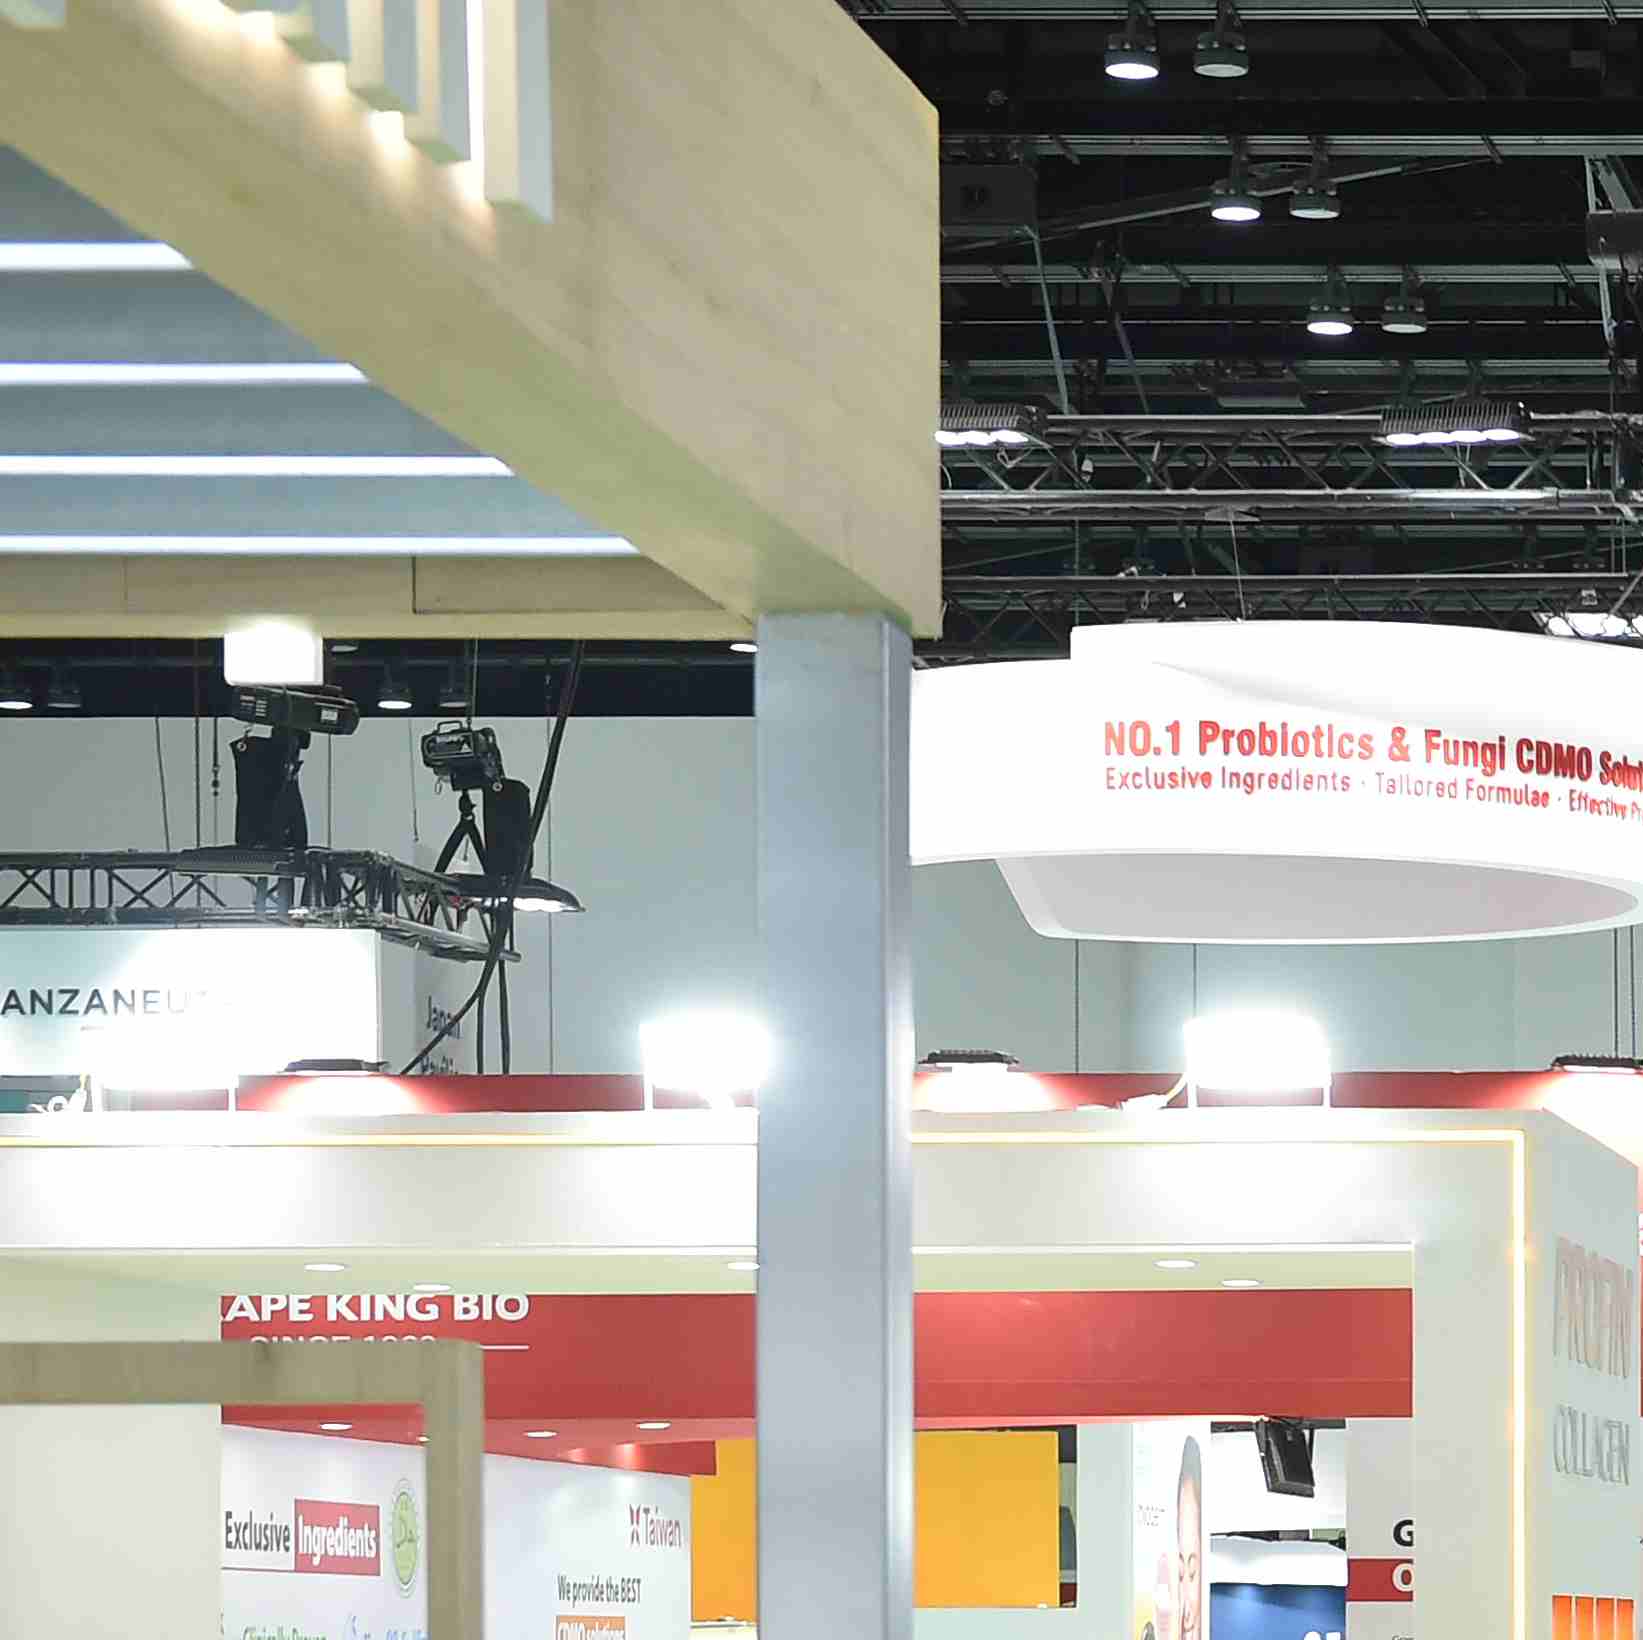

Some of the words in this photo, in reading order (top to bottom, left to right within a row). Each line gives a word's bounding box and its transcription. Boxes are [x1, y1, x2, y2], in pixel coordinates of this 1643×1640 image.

[1104, 719, 1181, 757] NO.1
[1198, 719, 1374, 761] Probiotics
[1388, 726, 1410, 762] &
[1423, 728, 1506, 777] Fungi
[1515, 737, 1593, 782] CDMO
[1105, 766, 1213, 790] Exclusive
[1220, 765, 1351, 795] Ingredients
[1375, 772, 1458, 800] Tailored
[1465, 777, 1550, 808] Formulae
[221, 1293, 314, 1322] APE
[326, 1293, 440, 1322] KING
[453, 1293, 530, 1322] BIO
[225, 1511, 291, 1553] Exclusive
[298, 1515, 378, 1565] Ingredients
[641, 1506, 682, 1549] Taiwan
[557, 1575, 571, 1601] We
[571, 1576, 604, 1608] provide
[605, 1577, 620, 1603] the
[620, 1578, 642, 1604] BEST
